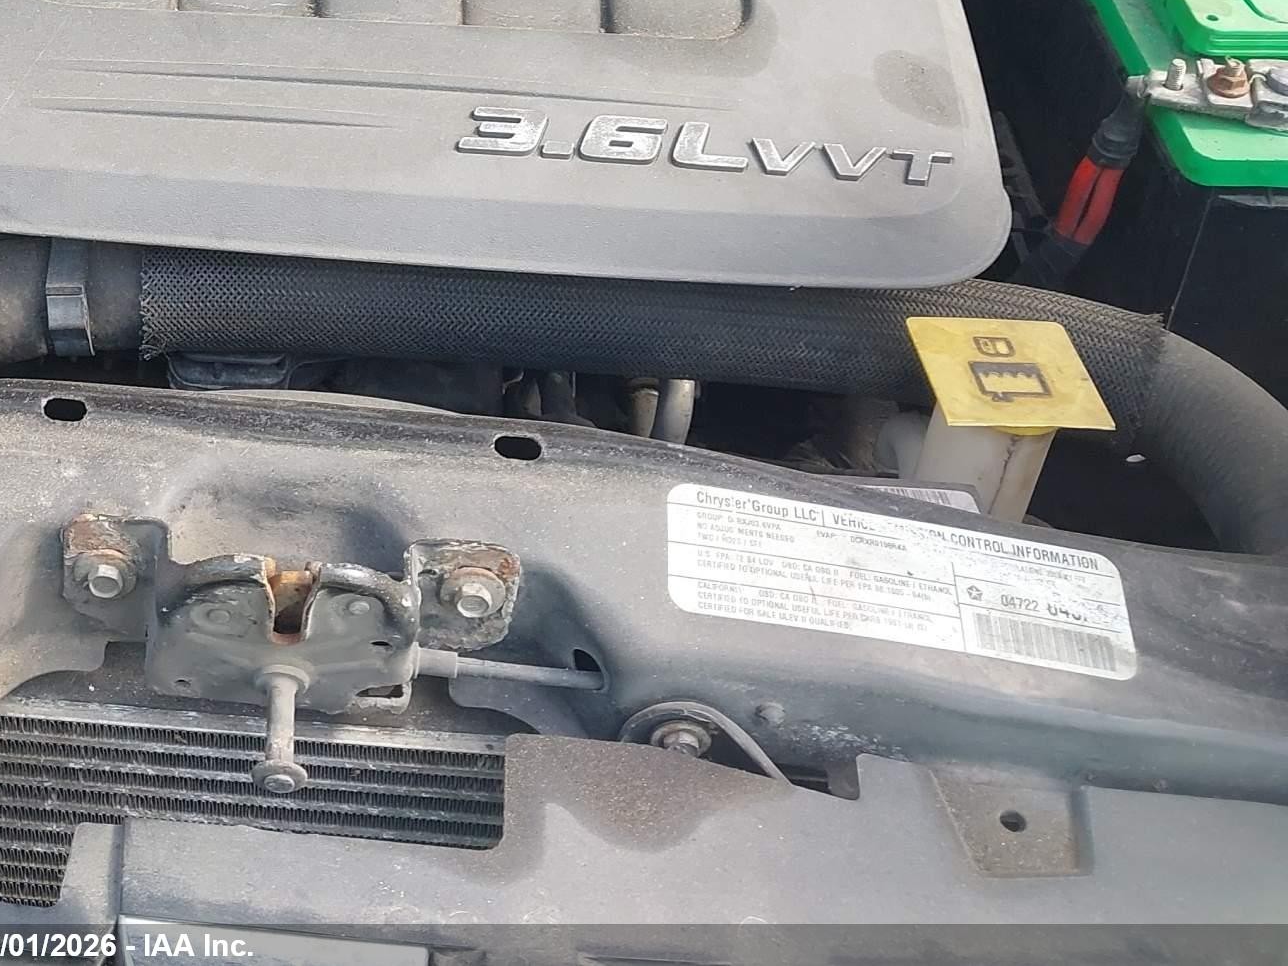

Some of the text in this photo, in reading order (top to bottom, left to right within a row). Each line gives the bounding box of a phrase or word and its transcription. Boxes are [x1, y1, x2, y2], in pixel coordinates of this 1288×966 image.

[751, 498, 788, 518] Group
[794, 505, 817, 522] LLC
[950, 532, 1008, 554] CONTROL
[1012, 543, 1098, 570] INFORMATION
[1000, 593, 1039, 612] 04722
